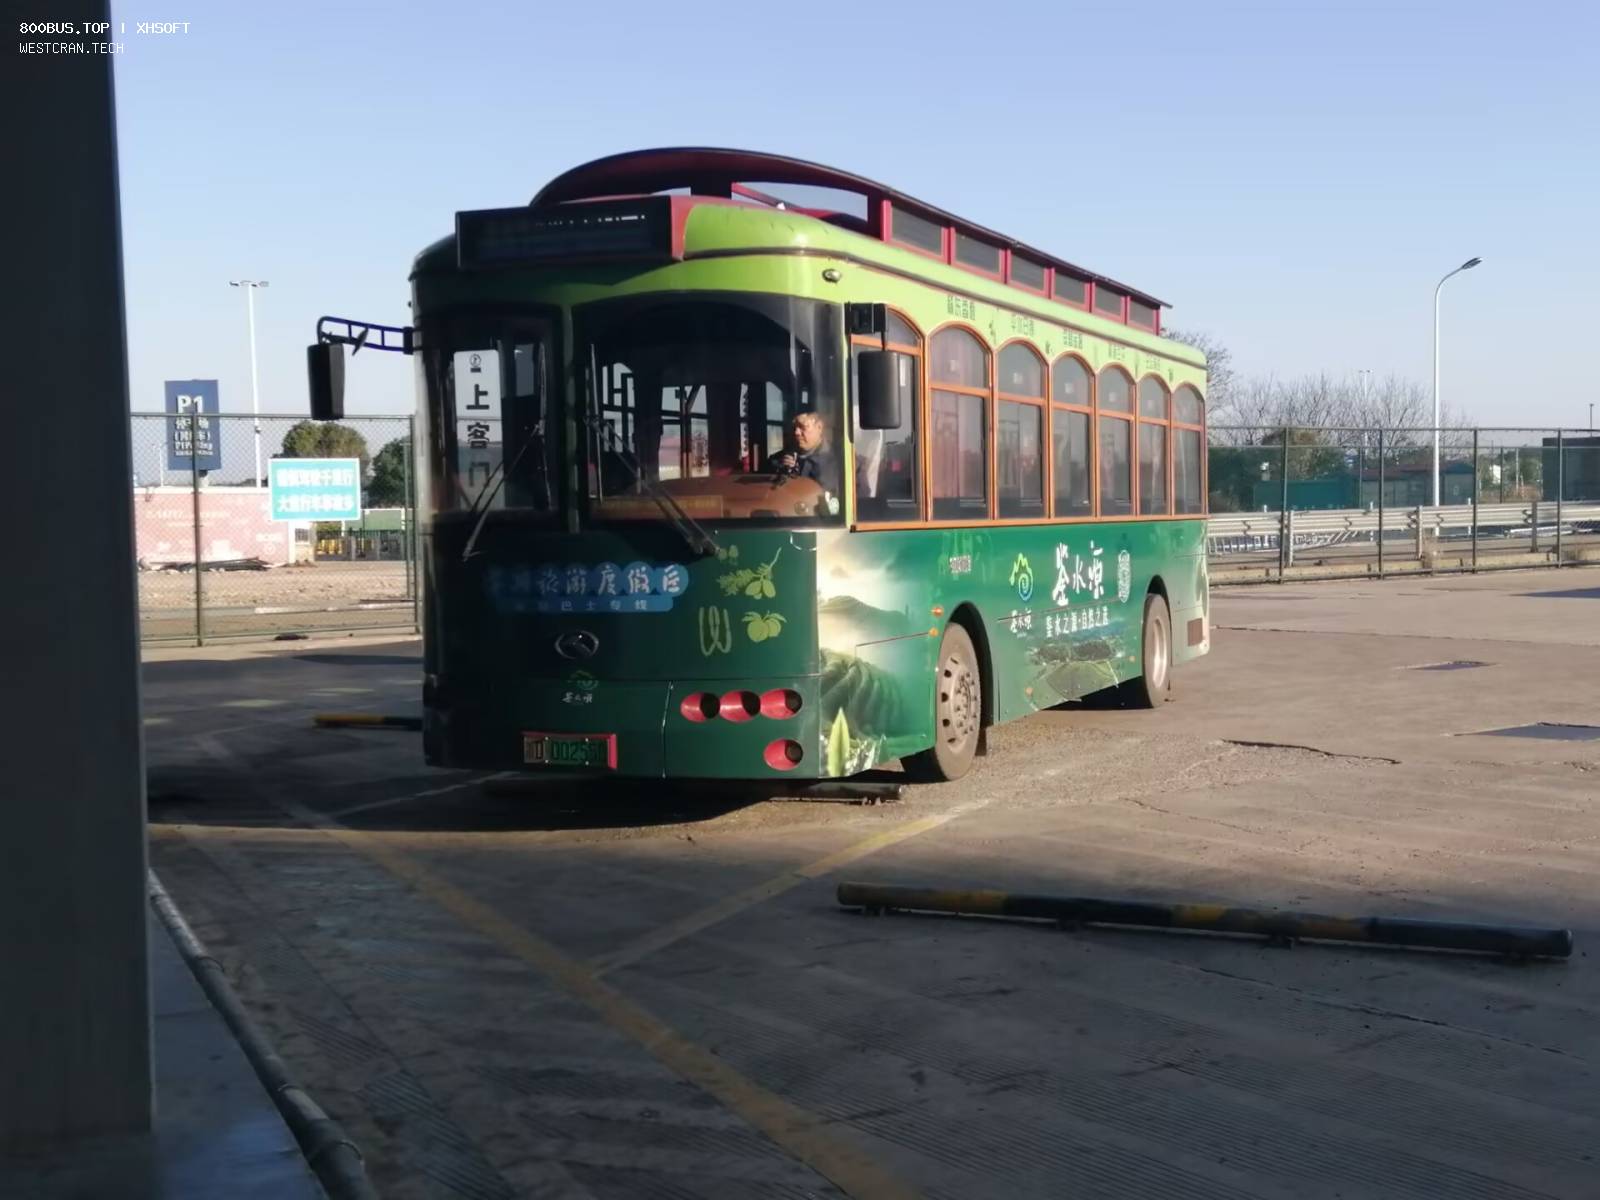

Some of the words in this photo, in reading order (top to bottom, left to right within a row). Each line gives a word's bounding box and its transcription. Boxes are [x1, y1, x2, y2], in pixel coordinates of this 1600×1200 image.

[177, 395, 204, 413] P1
[488, 563, 681, 594] 旅游度假区
